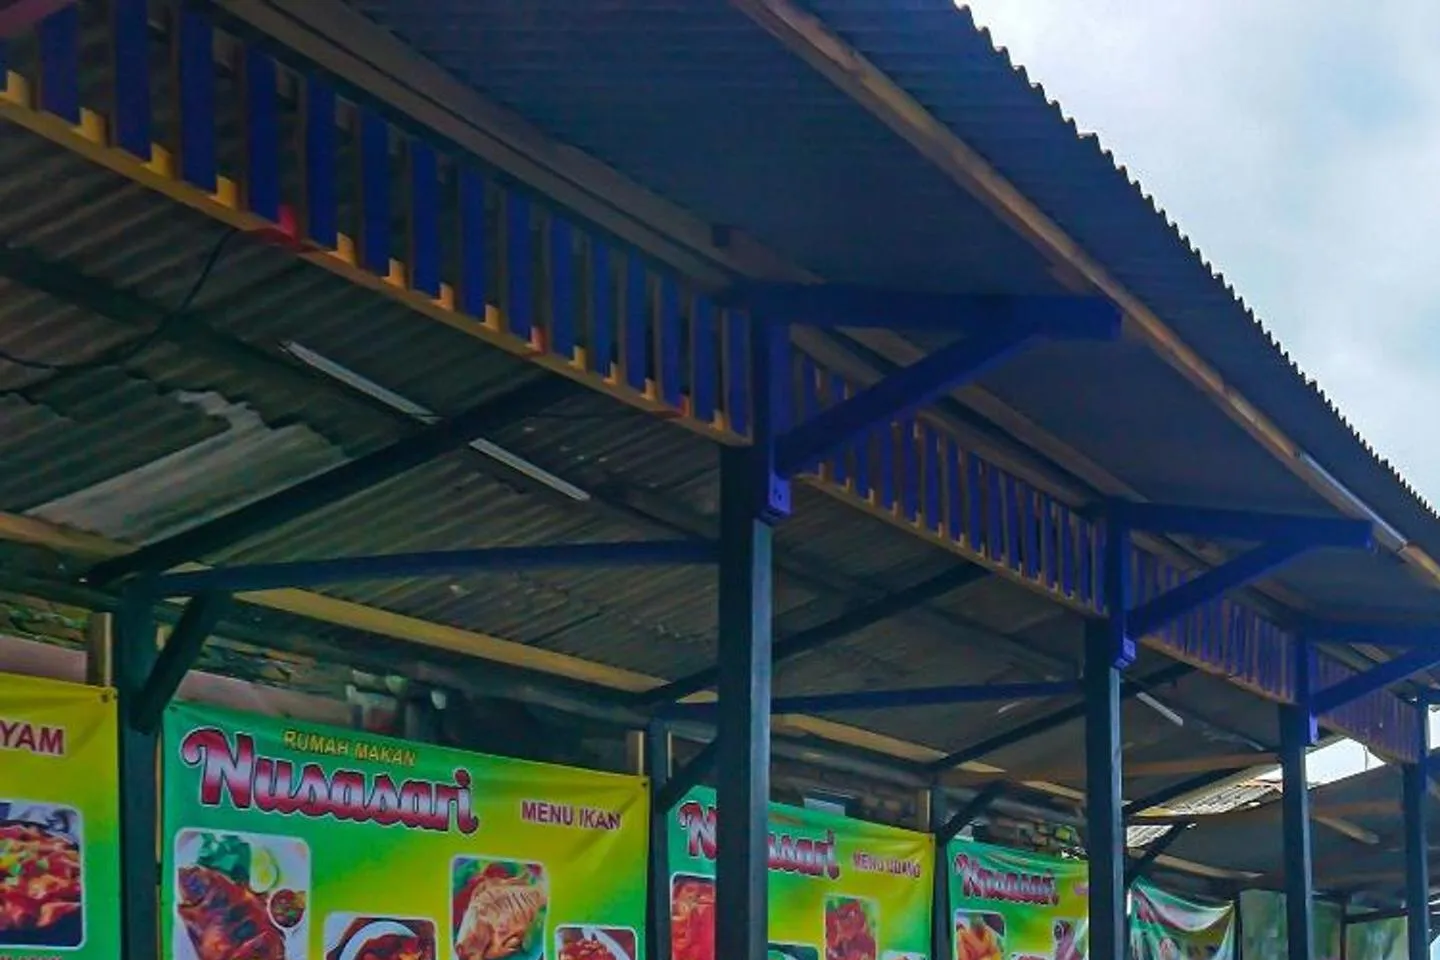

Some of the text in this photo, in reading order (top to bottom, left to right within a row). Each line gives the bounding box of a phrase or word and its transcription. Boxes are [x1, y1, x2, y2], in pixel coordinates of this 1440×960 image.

[284, 730, 416, 767] RUMAH MAKAN
[181, 727, 479, 835] Nusasari
[522, 800, 623, 830] MENU IKAN
